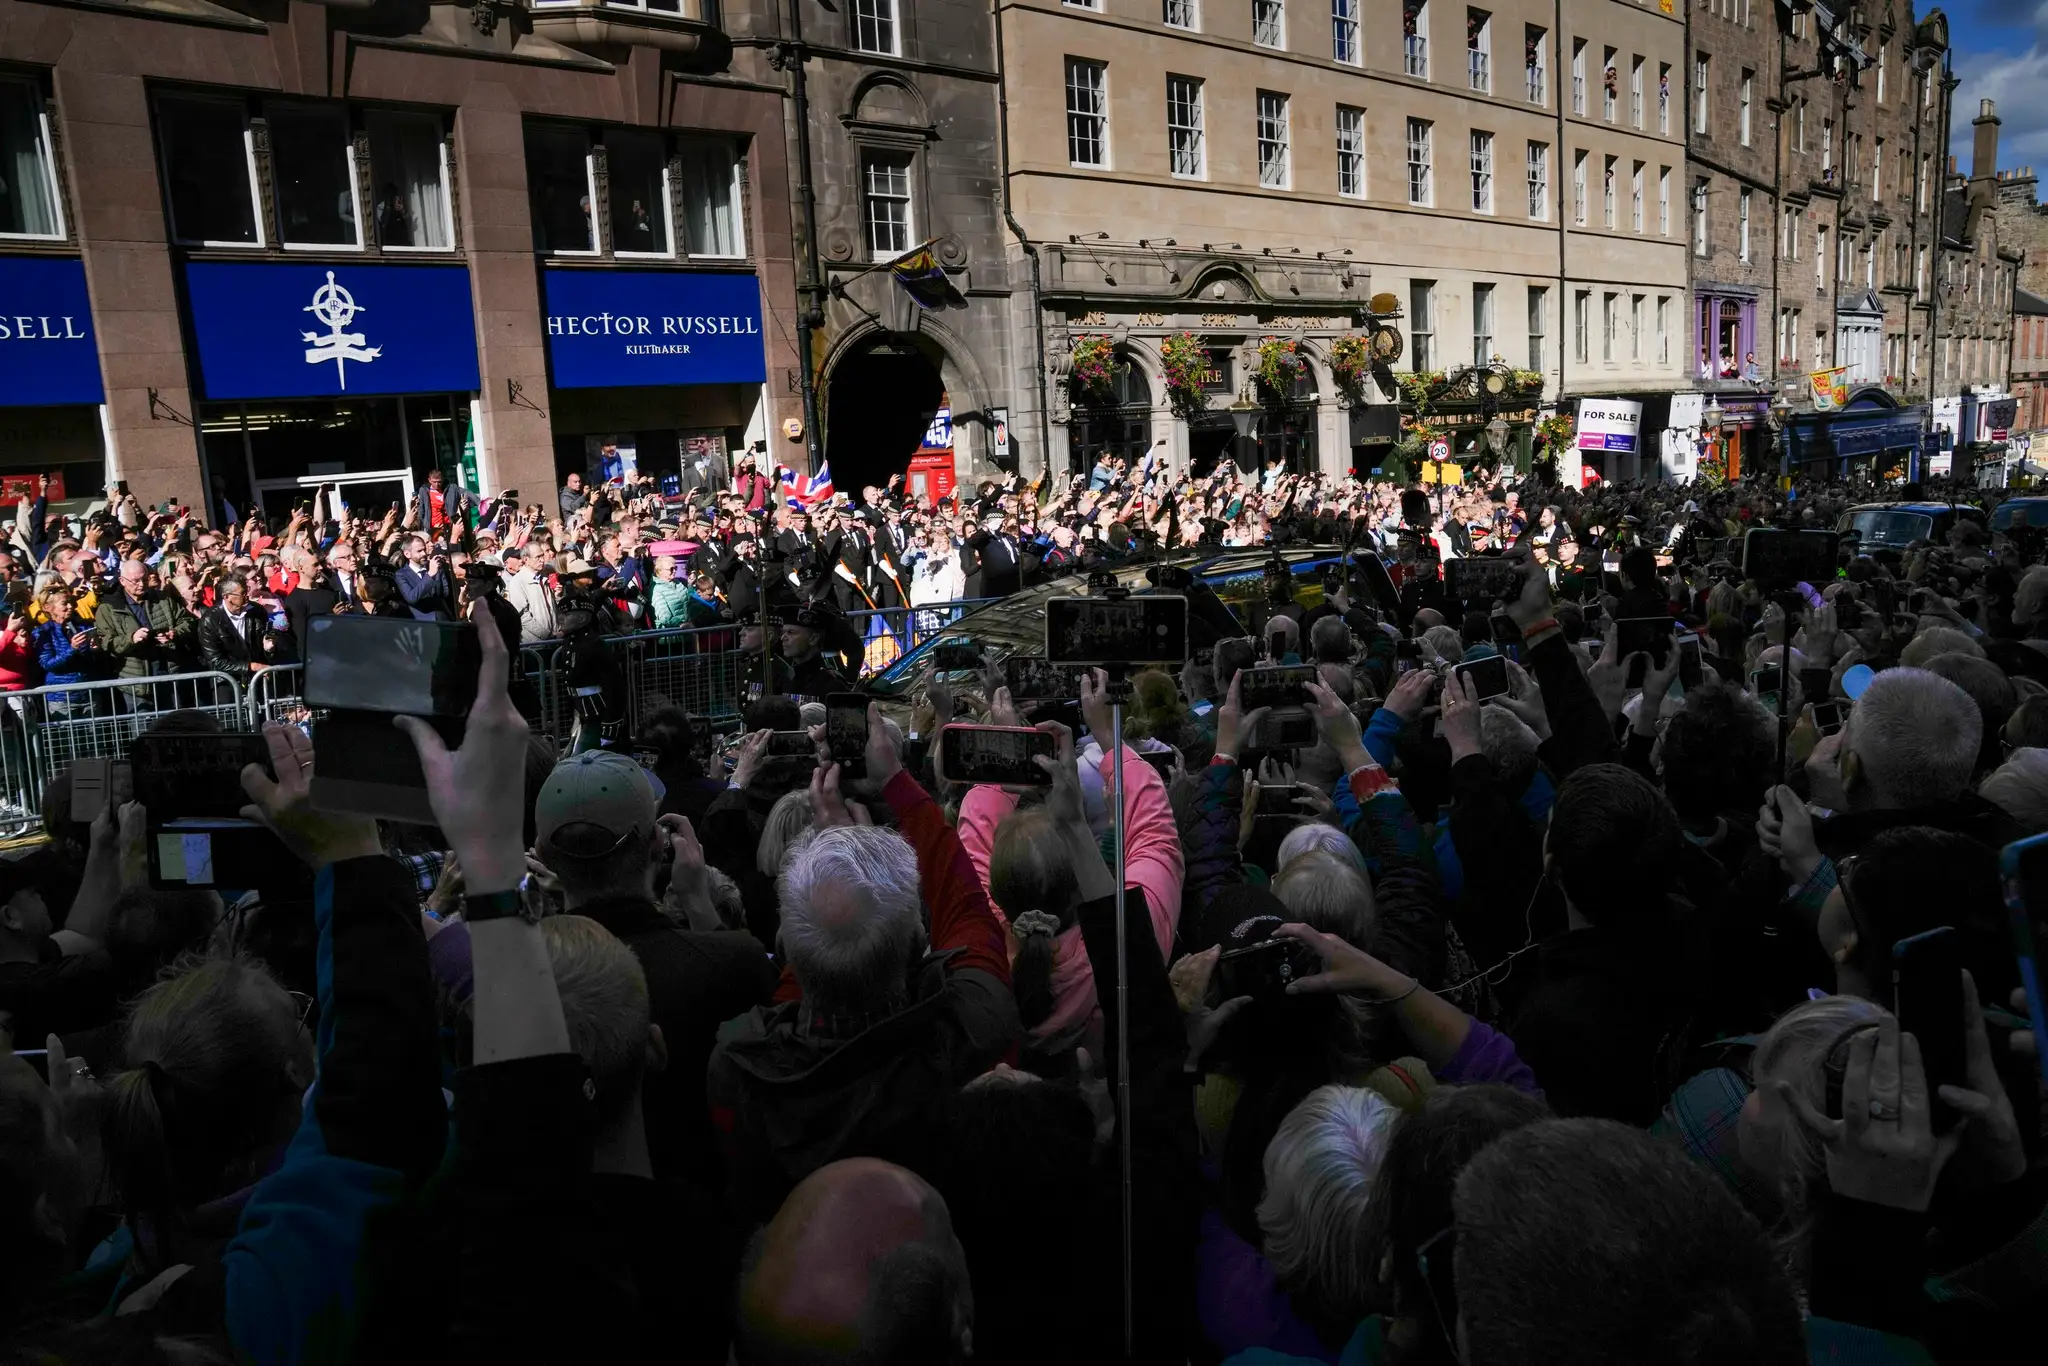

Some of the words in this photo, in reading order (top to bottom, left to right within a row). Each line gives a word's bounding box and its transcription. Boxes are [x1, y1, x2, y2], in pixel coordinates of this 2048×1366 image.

[546, 312, 653, 336] HECTOR
[662, 316, 759, 335] RUSSELL
[1137, 312, 1165, 326] AND
[1201, 313, 1238, 328] SPIRIT
[625, 344, 691, 355] KILTMAKER
[1584, 410, 1605, 420] FOR
[1608, 412, 1637, 422] SALE
[1434, 446, 1447, 457] 20
